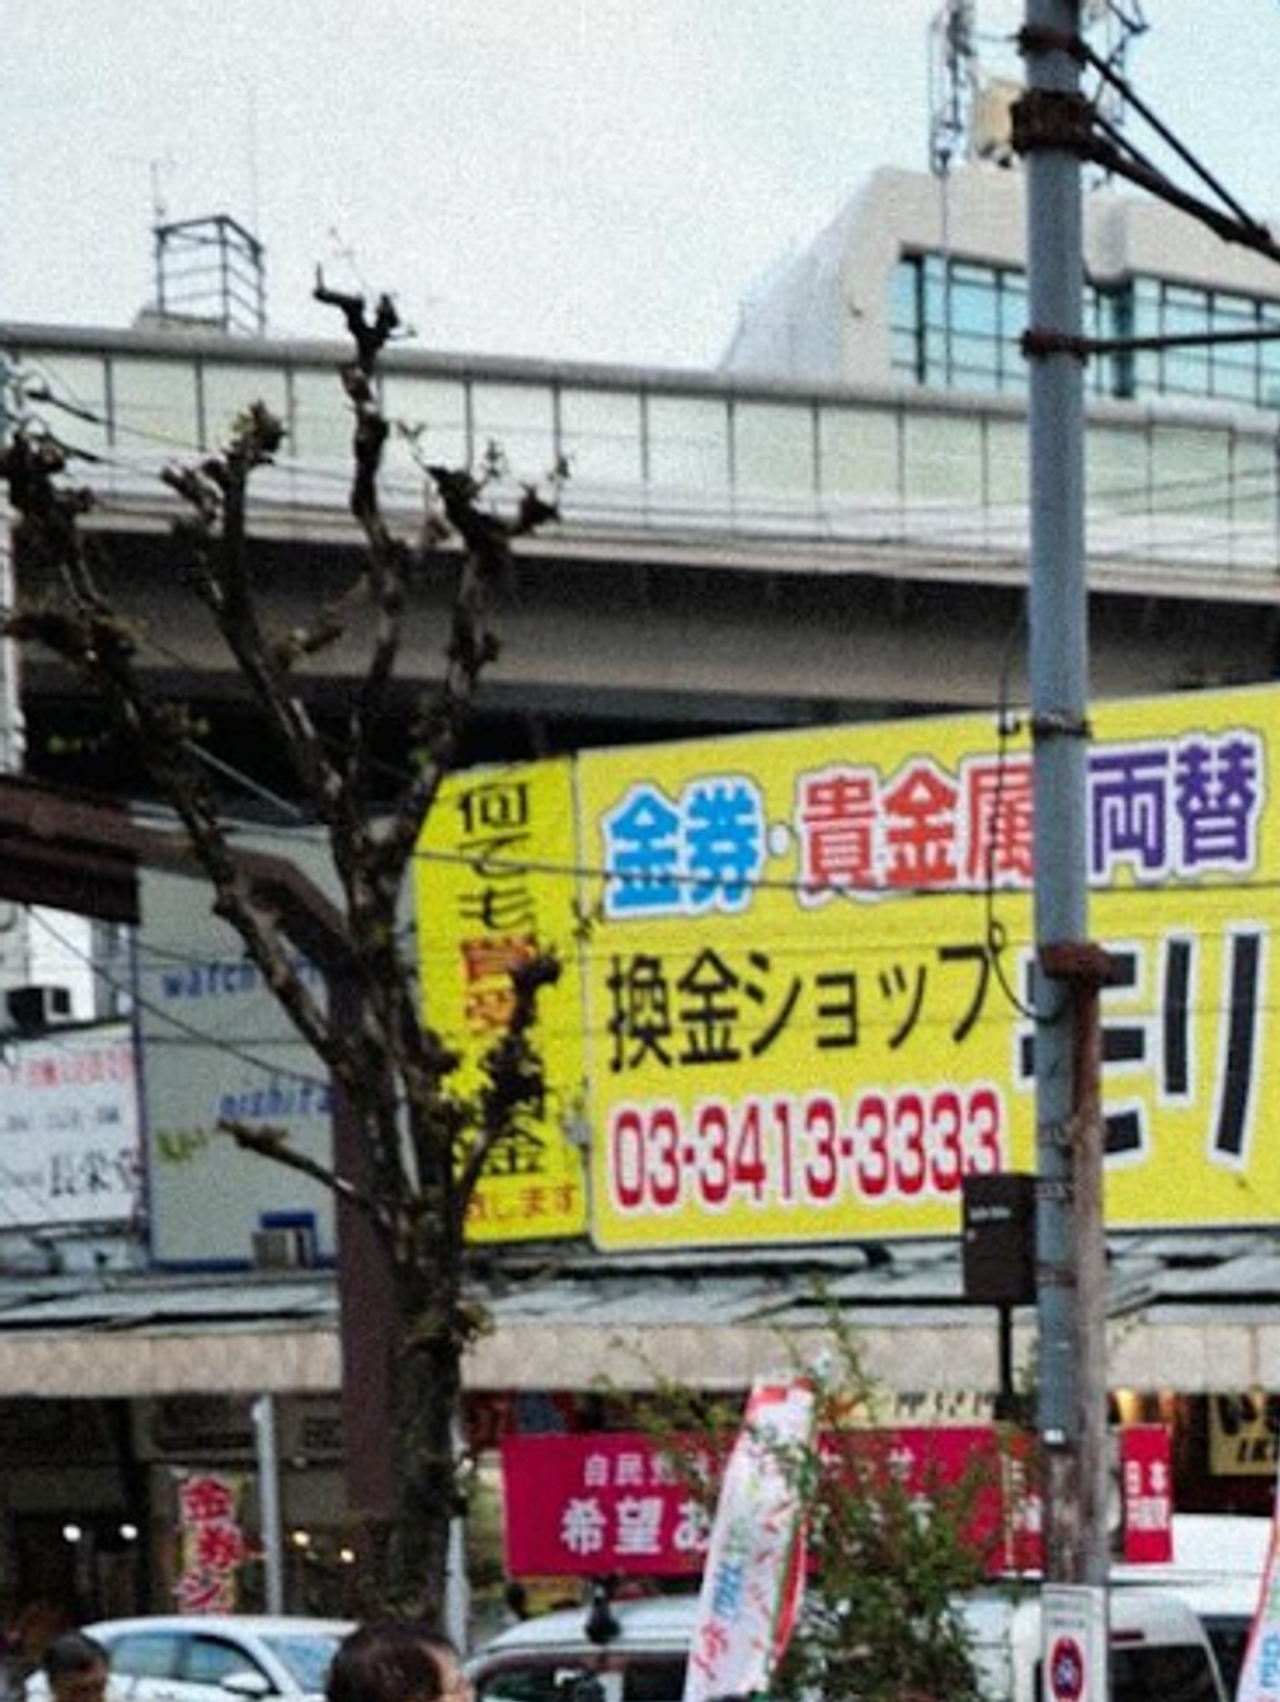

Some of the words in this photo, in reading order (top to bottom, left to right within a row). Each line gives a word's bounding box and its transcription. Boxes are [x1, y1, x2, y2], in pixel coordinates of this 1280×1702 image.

[606, 925, 1006, 1072] 換金ショップ
[615, 1090, 1000, 1208] 03-3413-3333
